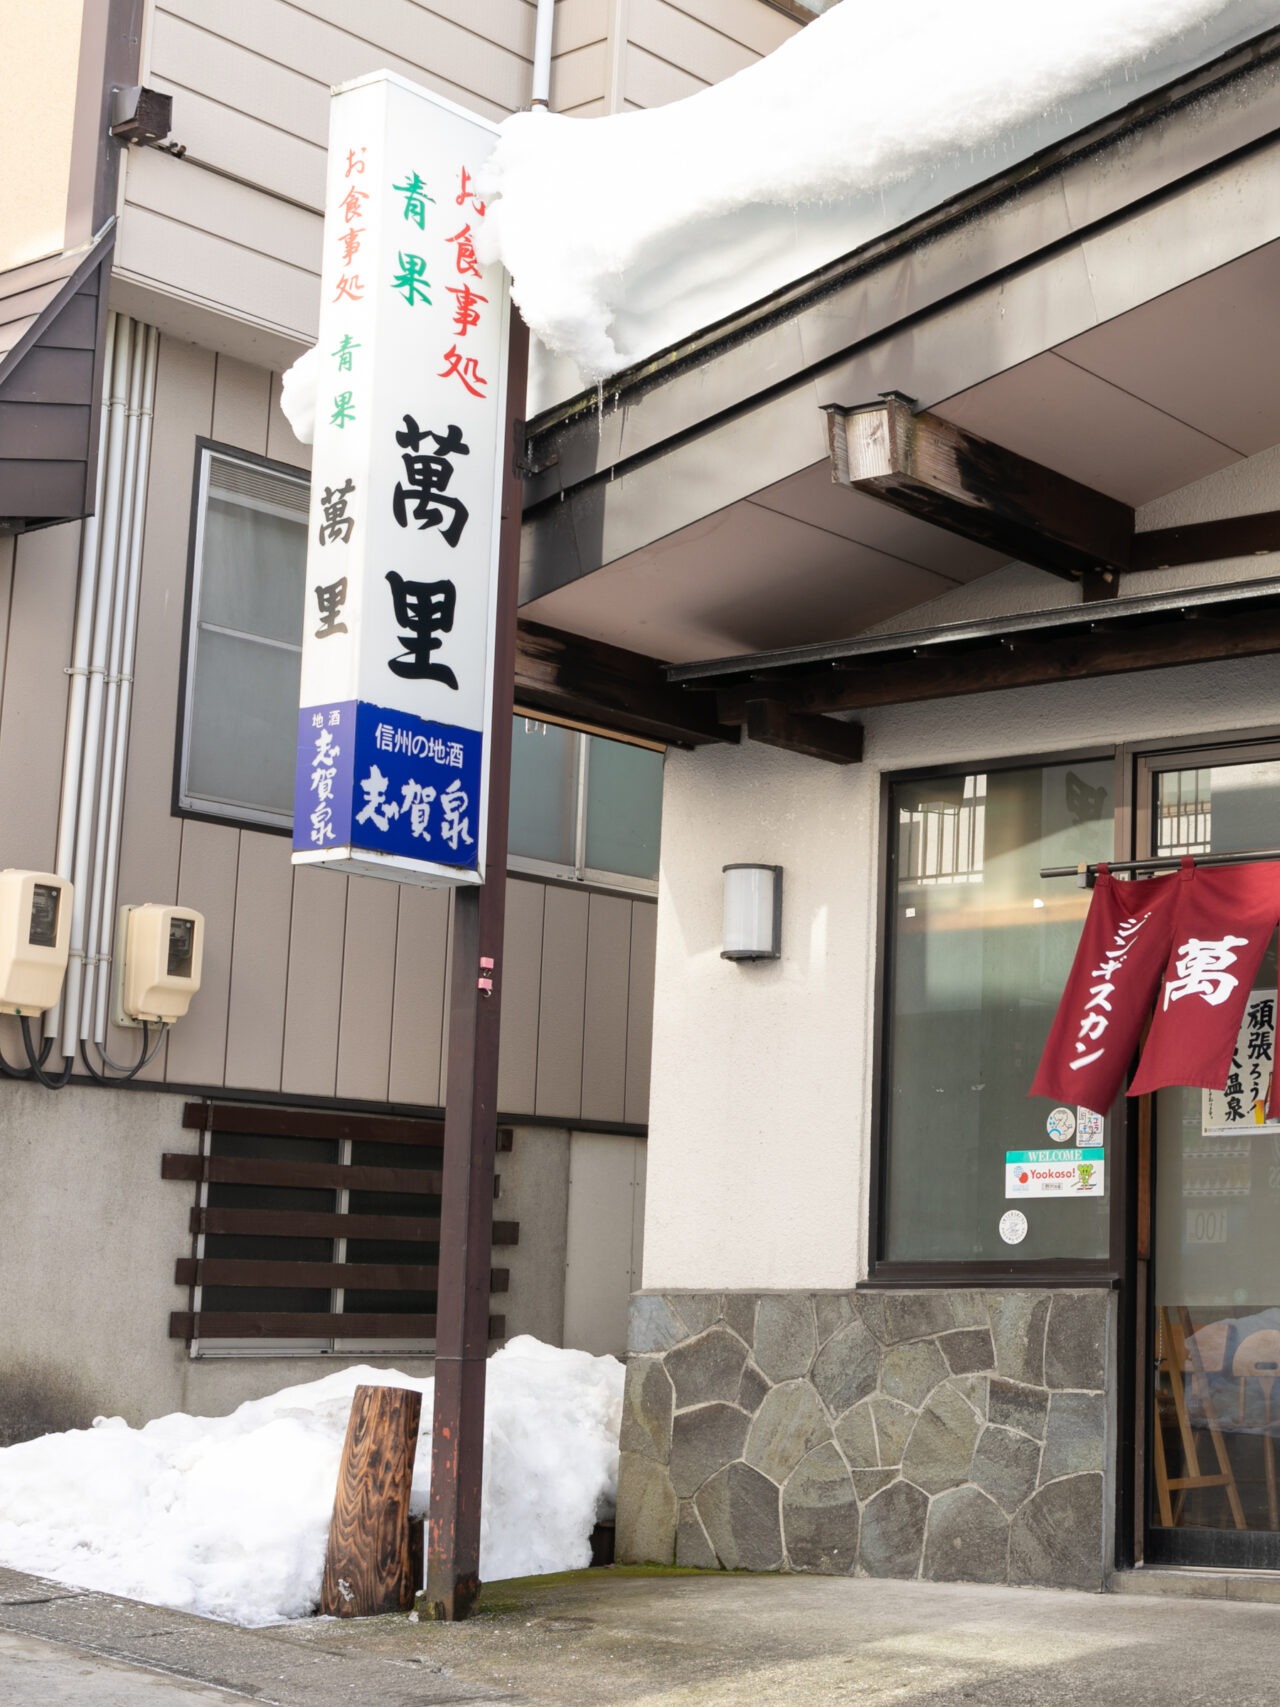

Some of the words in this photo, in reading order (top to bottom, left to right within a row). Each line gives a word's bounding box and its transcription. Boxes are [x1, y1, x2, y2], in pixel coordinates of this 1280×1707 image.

[332, 147, 370, 303] お食事処
[390, 170, 436, 307] 青果
[329, 334, 362, 430] 青果
[314, 478, 356, 640] 萬里
[384, 414, 471, 691] 萬里
[311, 709, 341, 727] 地酒
[375, 722, 464, 769] 信州の地酒
[310, 729, 340, 846] 志賀泉
[355, 764, 474, 850] 志賀泉
[1069, 912, 1152, 1070] ジンギスカン
[1027, 1150, 1082, 1162] WELCOME
[1030, 1168, 1076, 1180] Yookoso!
